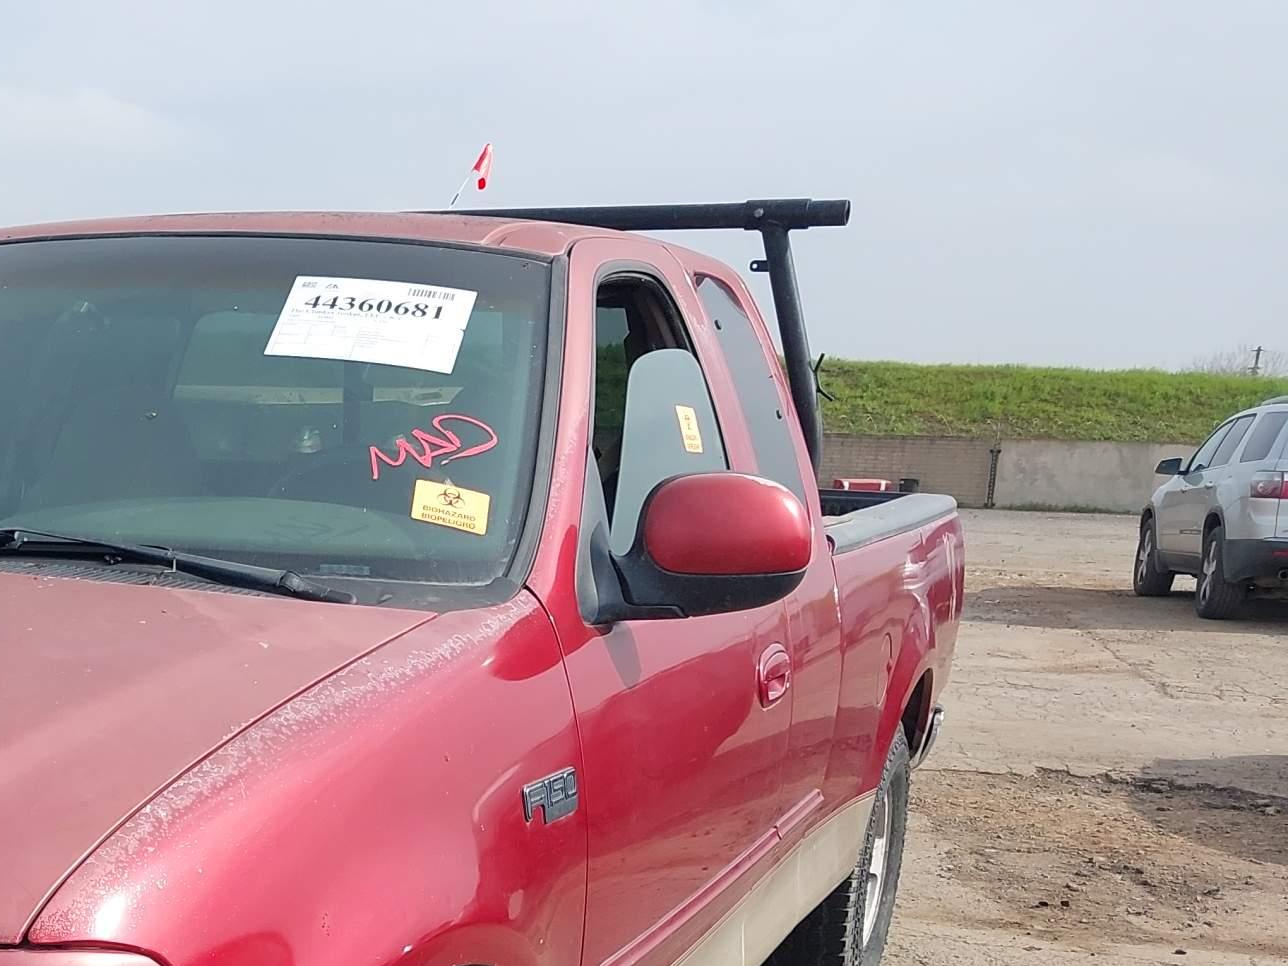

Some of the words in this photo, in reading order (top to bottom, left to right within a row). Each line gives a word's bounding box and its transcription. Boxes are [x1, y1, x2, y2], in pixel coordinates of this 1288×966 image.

[303, 294, 443, 320] 44360681
[421, 512, 476, 530] BIOPELIGRO
[422, 504, 476, 522] BIOHAZARD
